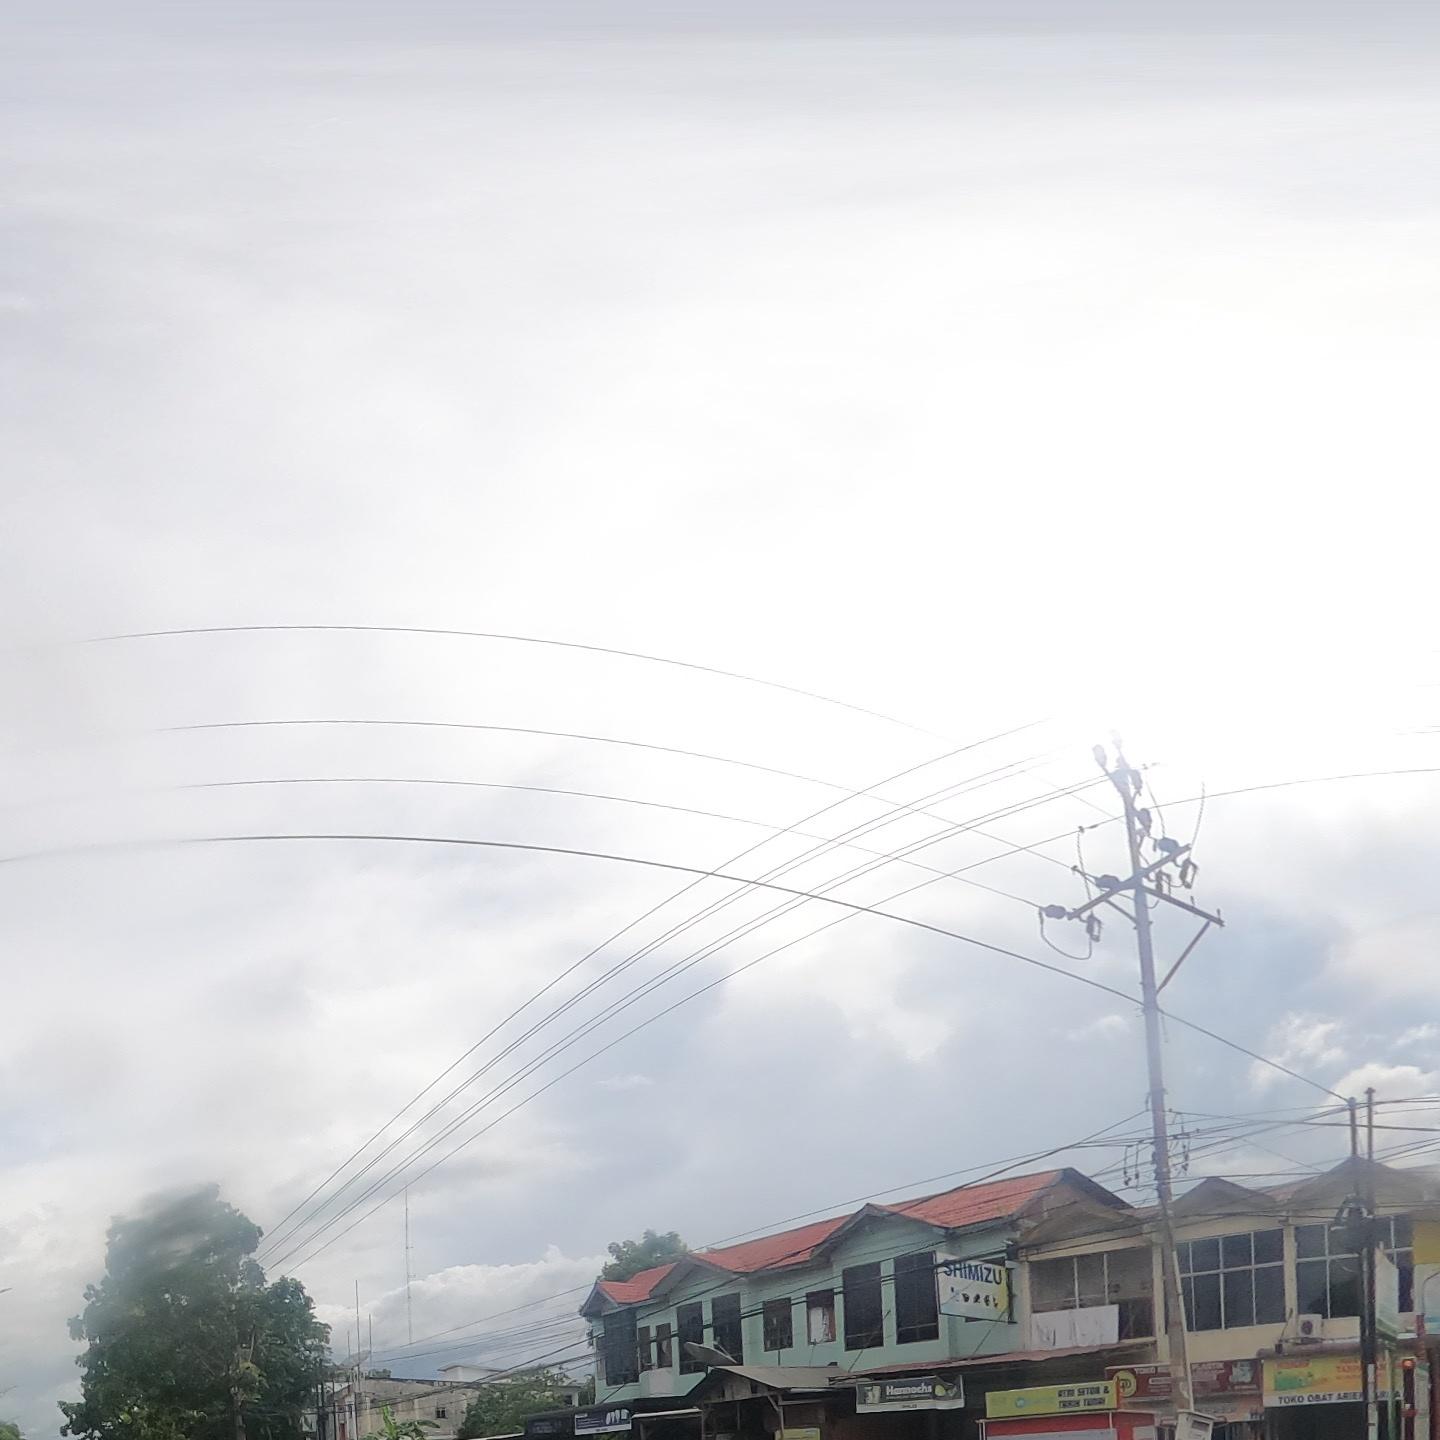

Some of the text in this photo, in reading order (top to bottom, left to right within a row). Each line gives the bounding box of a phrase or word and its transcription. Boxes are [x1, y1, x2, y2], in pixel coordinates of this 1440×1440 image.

[943, 1262, 1002, 1285] SHIMIZU
[1278, 1395, 1304, 1405] TOKO
[1307, 1393, 1333, 1402] OBAT
